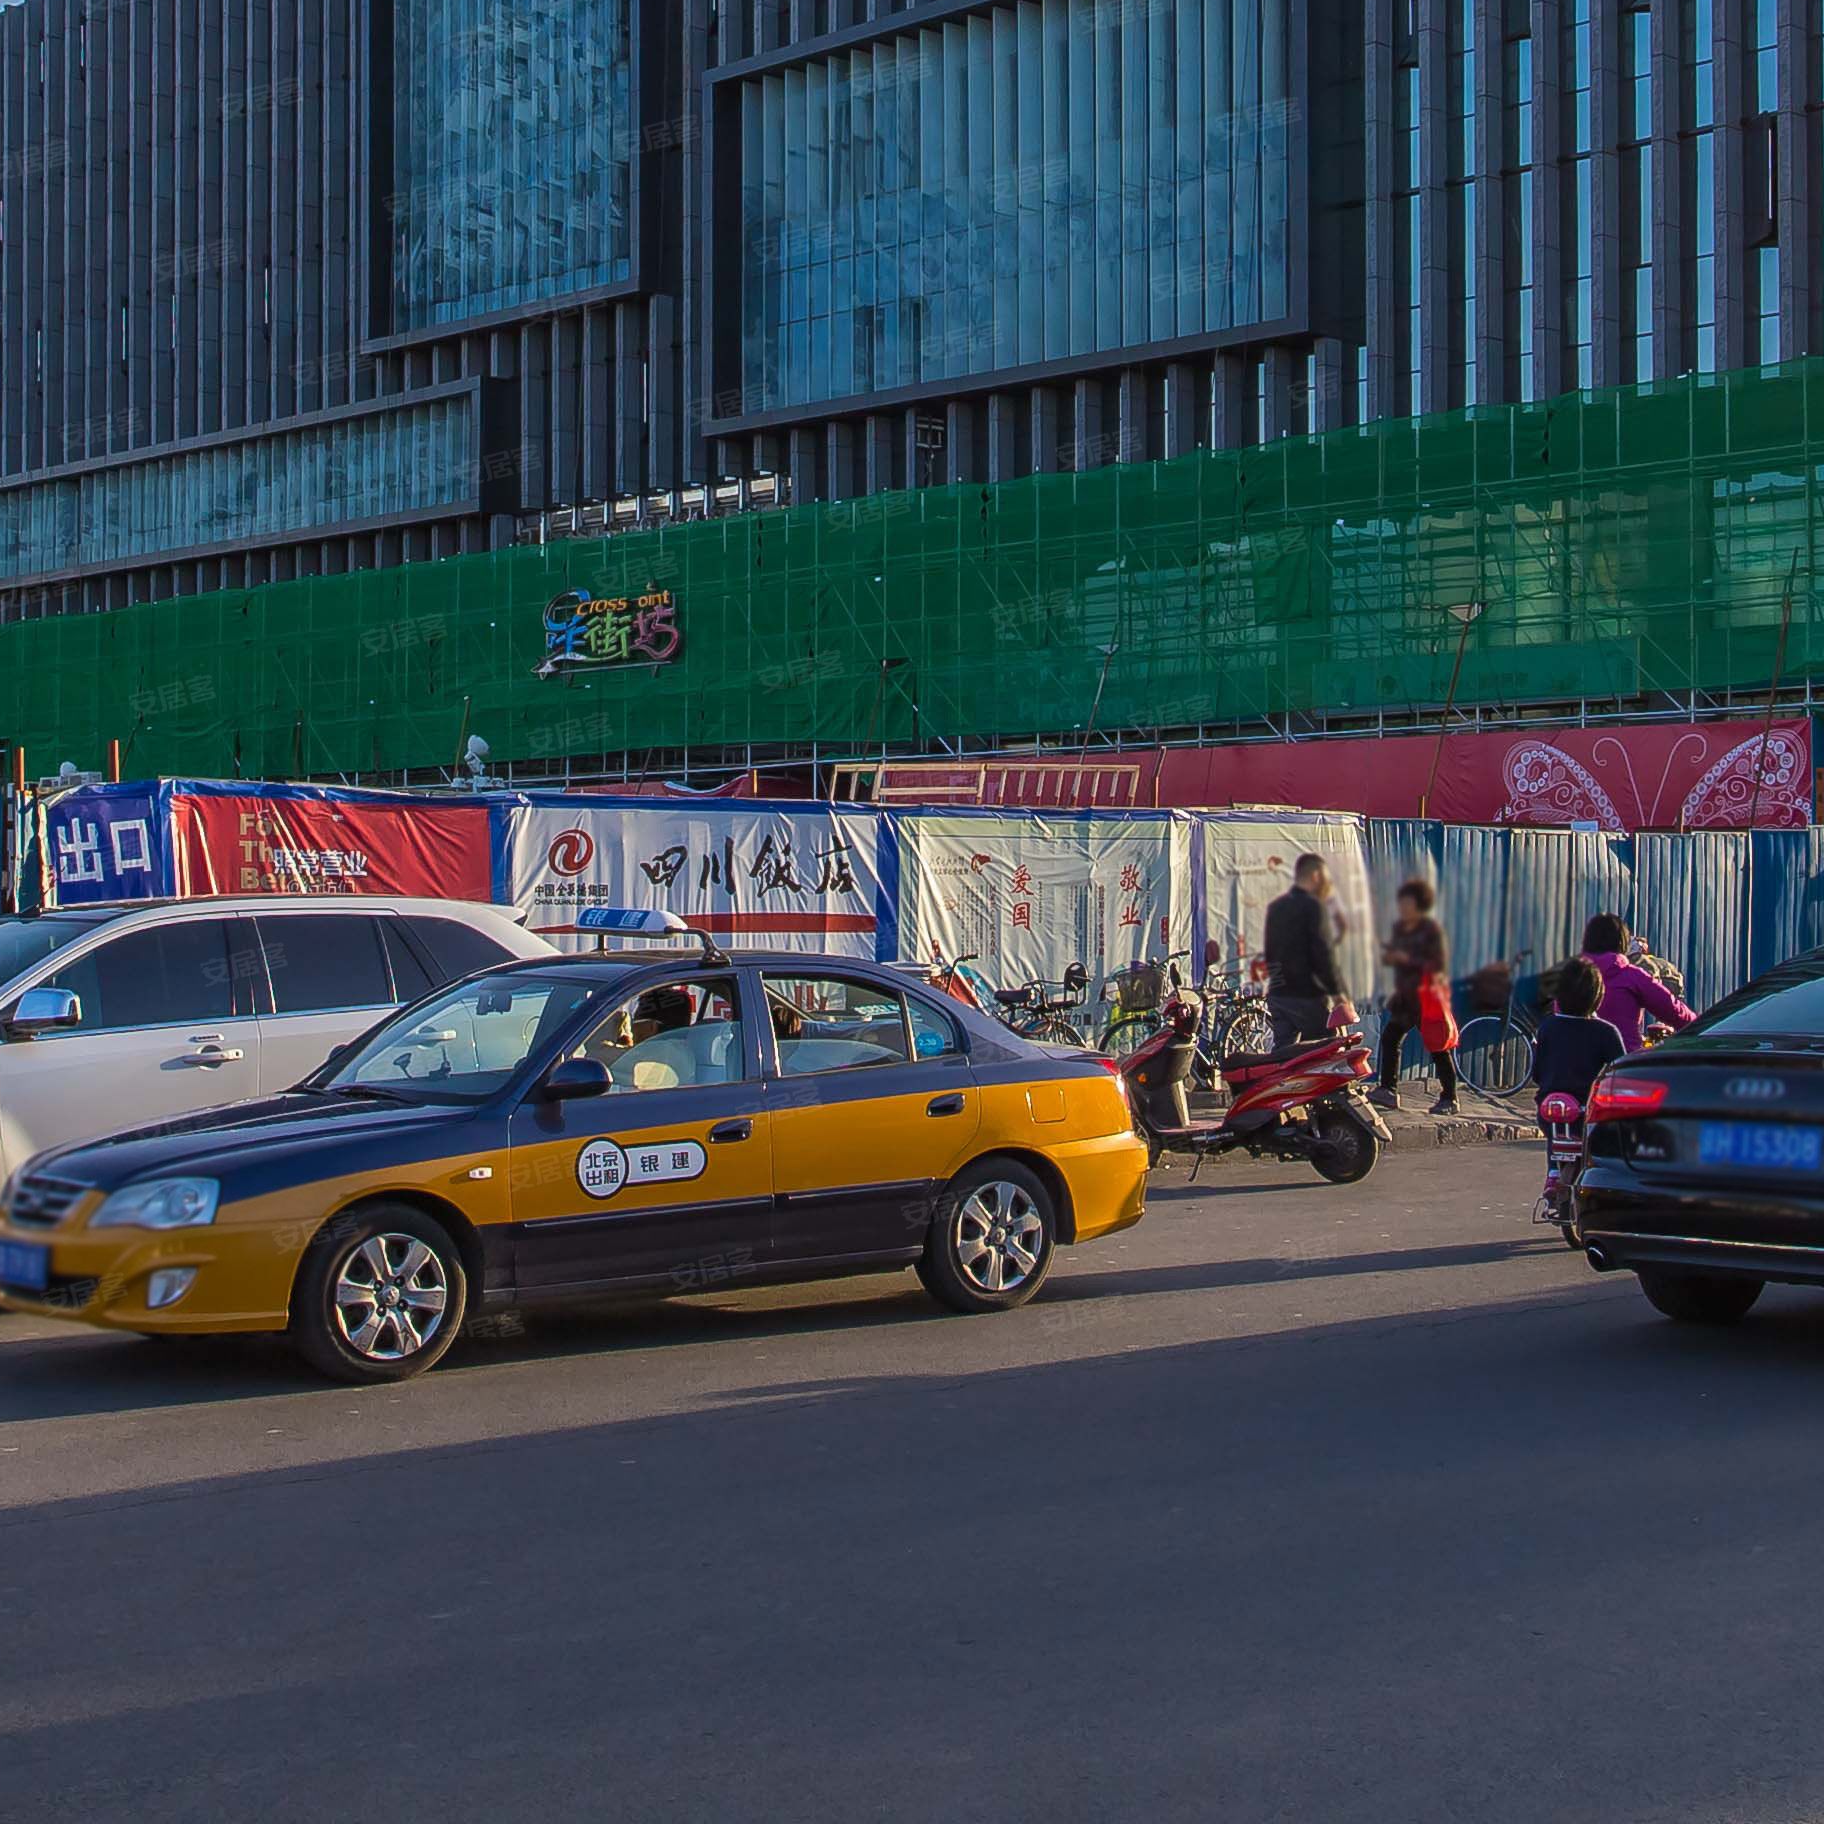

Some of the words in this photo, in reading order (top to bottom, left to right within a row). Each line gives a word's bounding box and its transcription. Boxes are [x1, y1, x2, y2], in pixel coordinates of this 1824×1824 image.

[57, 817, 153, 883] 出口
[273, 849, 369, 877] 照常营业
[640, 834, 857, 898] 四川饭店
[1011, 864, 1034, 932] 爱国
[1119, 864, 1143, 928] 敬业
[585, 1150, 619, 1168] 北京
[585, 1170, 619, 1186] 出租
